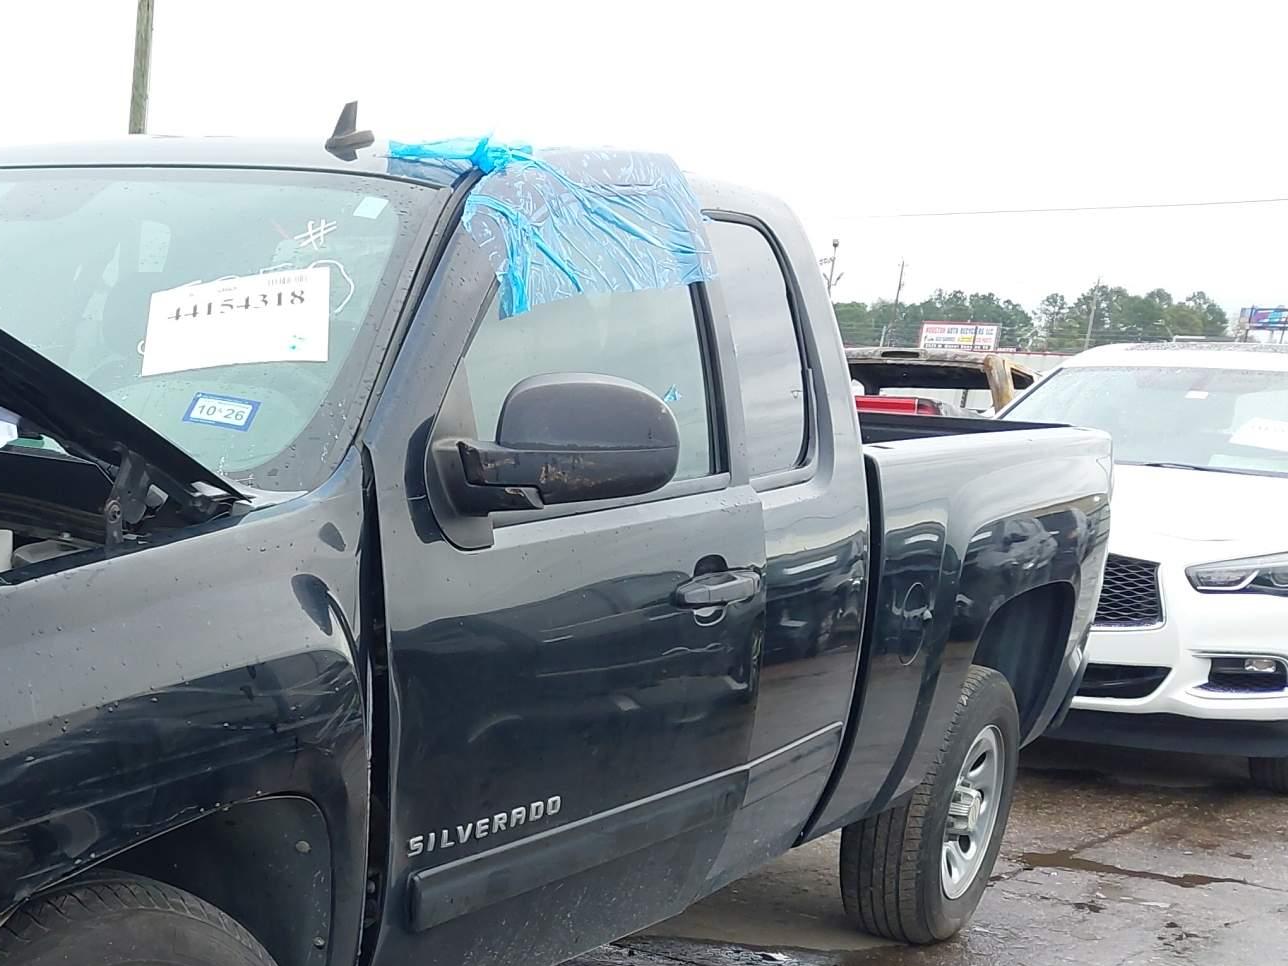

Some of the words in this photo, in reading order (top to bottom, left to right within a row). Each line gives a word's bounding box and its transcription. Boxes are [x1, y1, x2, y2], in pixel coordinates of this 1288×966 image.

[168, 290, 305, 320] 44154318
[198, 405, 217, 416] 10
[223, 408, 246, 421] 26
[407, 795, 561, 858] SILVERADO
